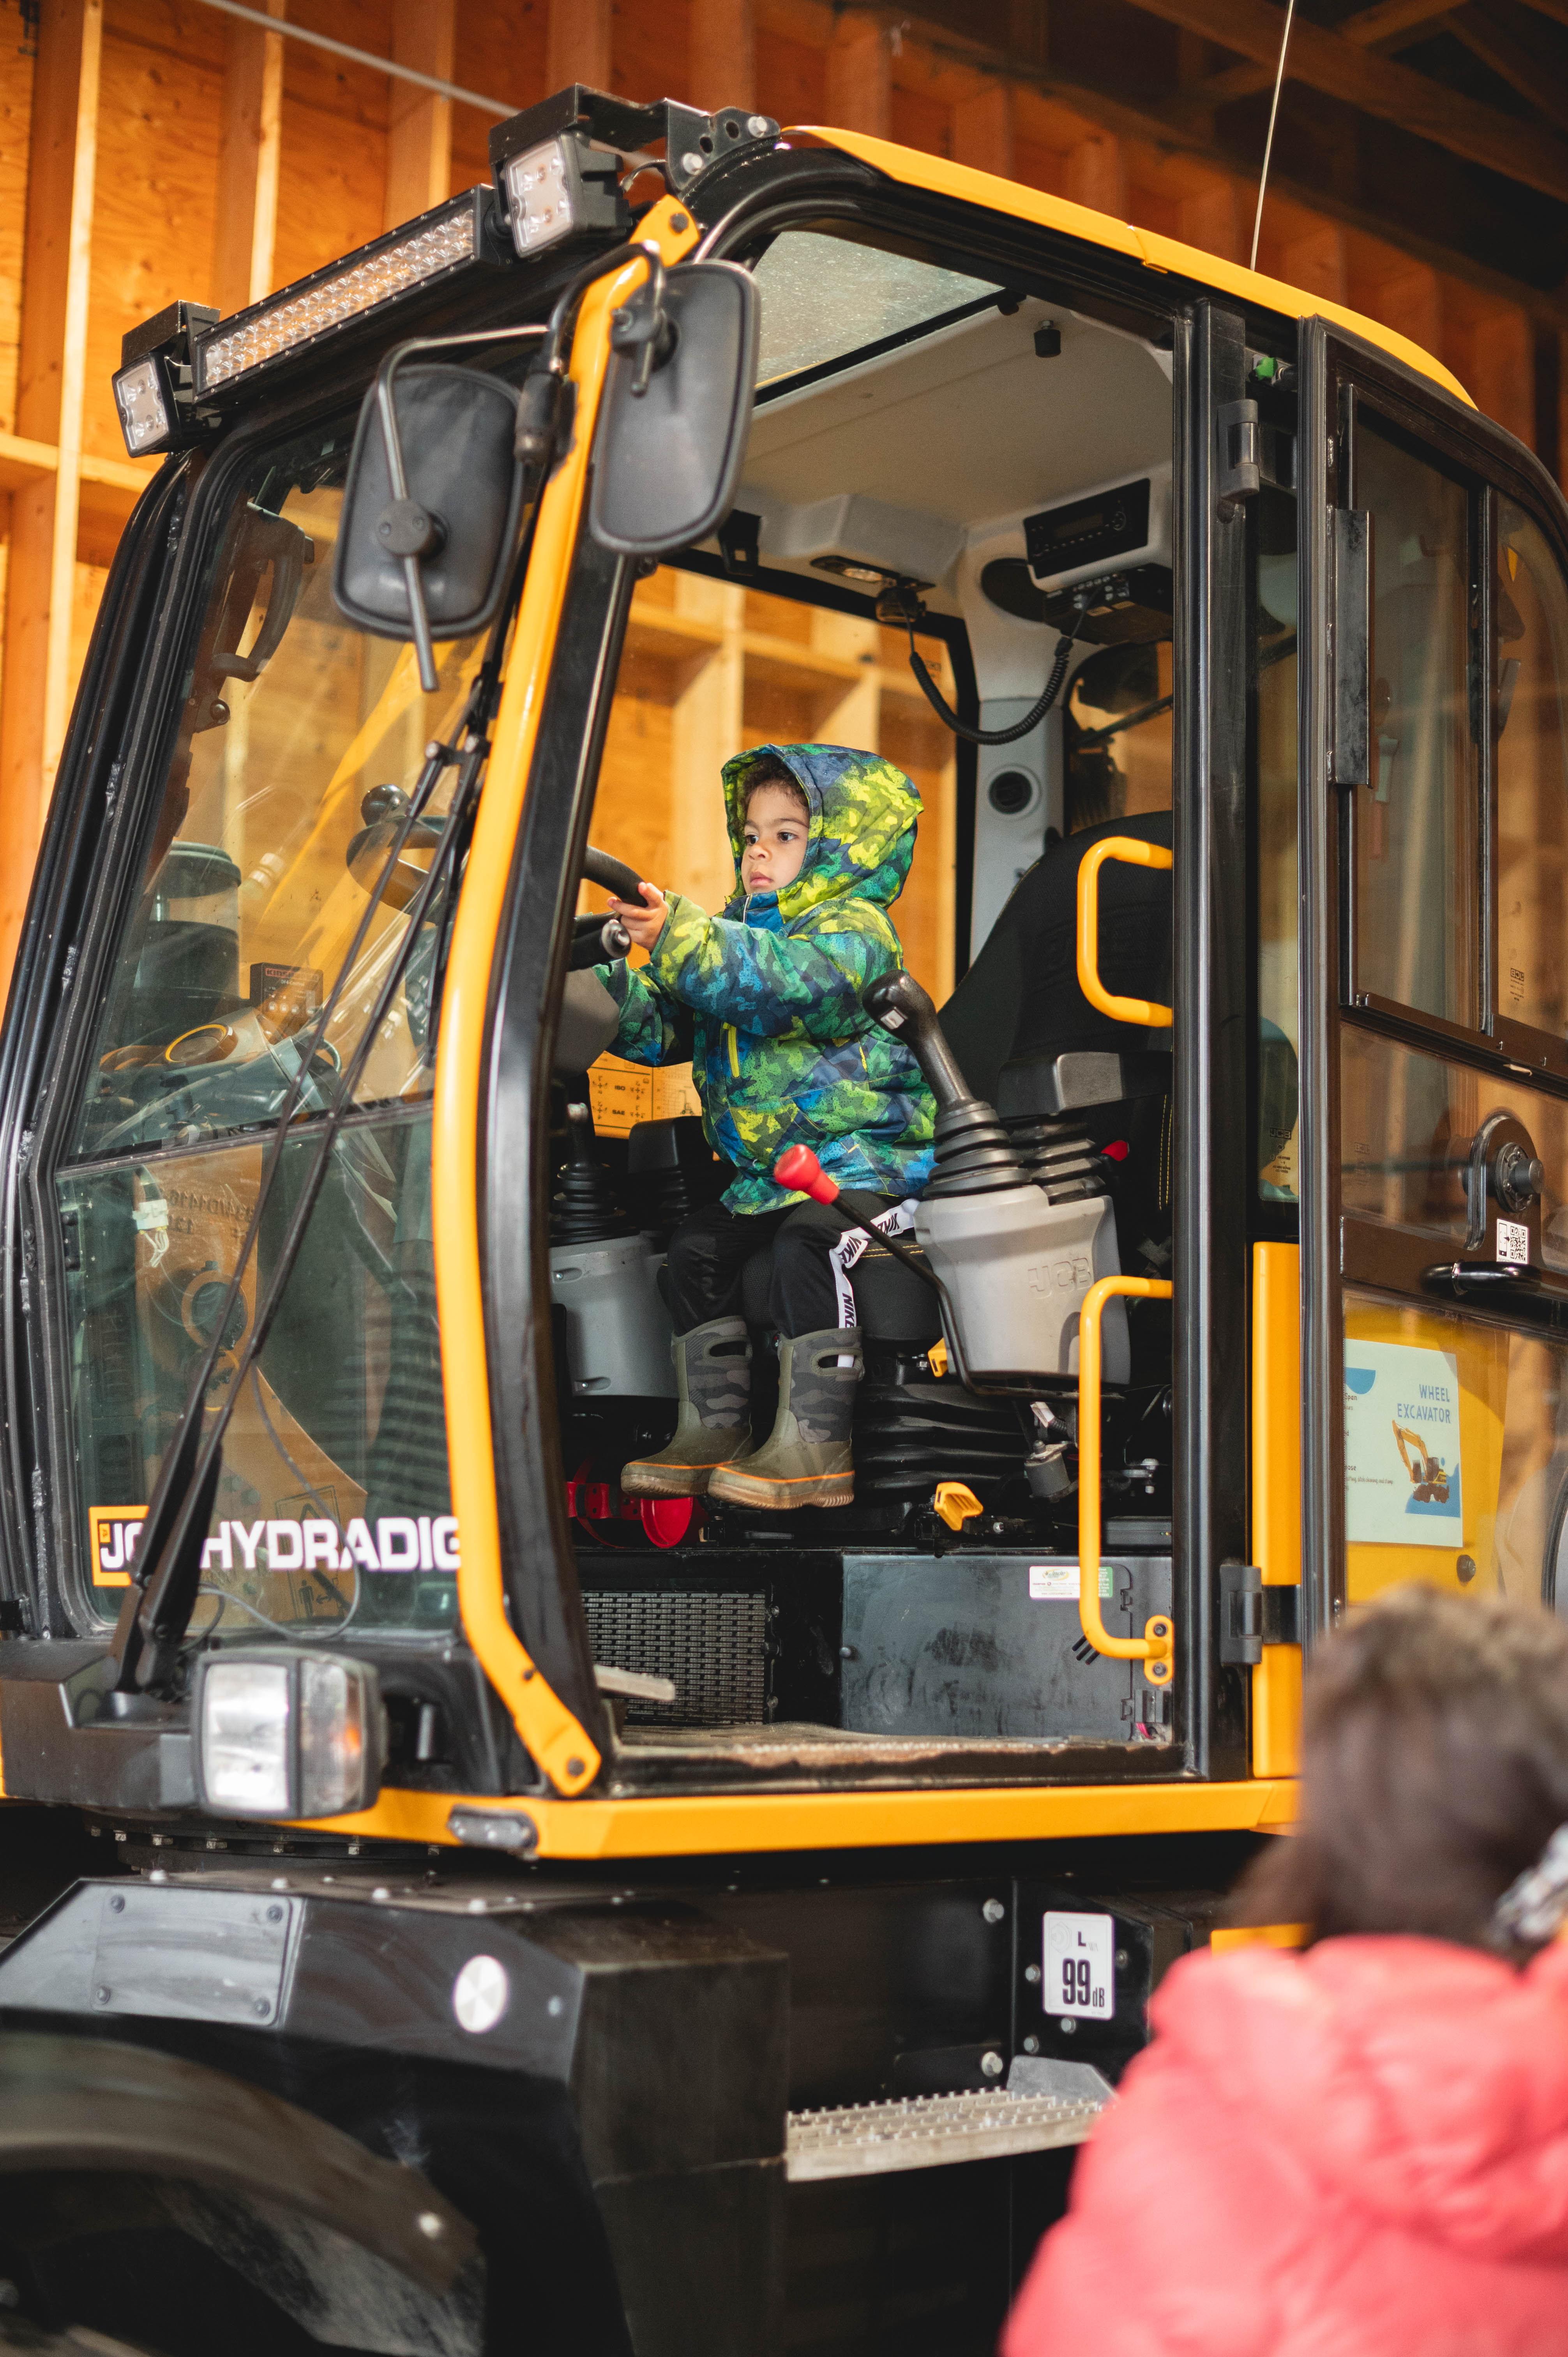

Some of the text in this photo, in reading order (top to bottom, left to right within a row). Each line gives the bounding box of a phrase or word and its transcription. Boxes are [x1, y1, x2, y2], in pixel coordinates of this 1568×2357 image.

[1270, 1127, 1291, 1140] JCB
[1419, 1384, 1450, 1402] WHEEL
[1397, 1403, 1450, 1424] EXCAVATOR
[1062, 1958, 1105, 2007] 99 dB
